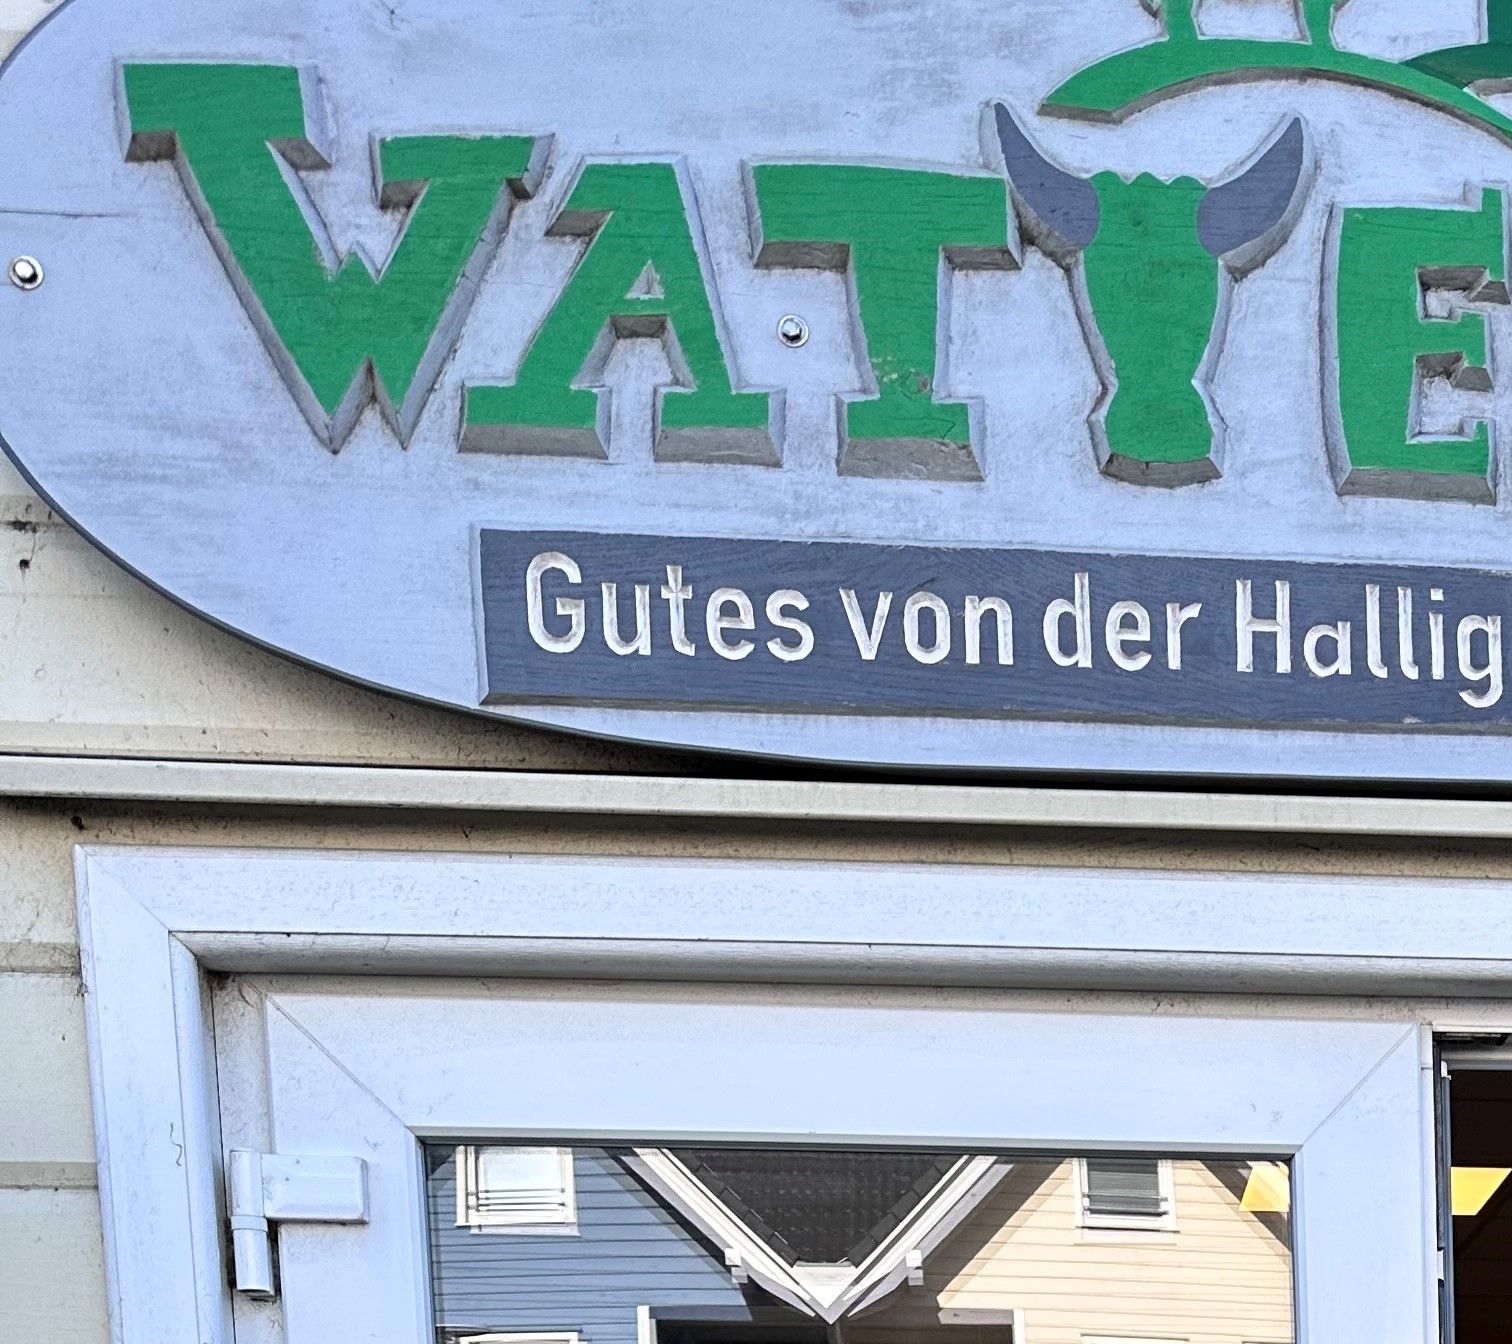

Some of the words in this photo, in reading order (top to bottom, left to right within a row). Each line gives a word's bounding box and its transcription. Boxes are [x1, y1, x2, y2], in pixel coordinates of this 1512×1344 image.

[525, 551, 815, 661] Gutes
[839, 587, 1014, 665] von
[1042, 572, 1202, 671] der
[1235, 578, 1503, 708] Hallig
